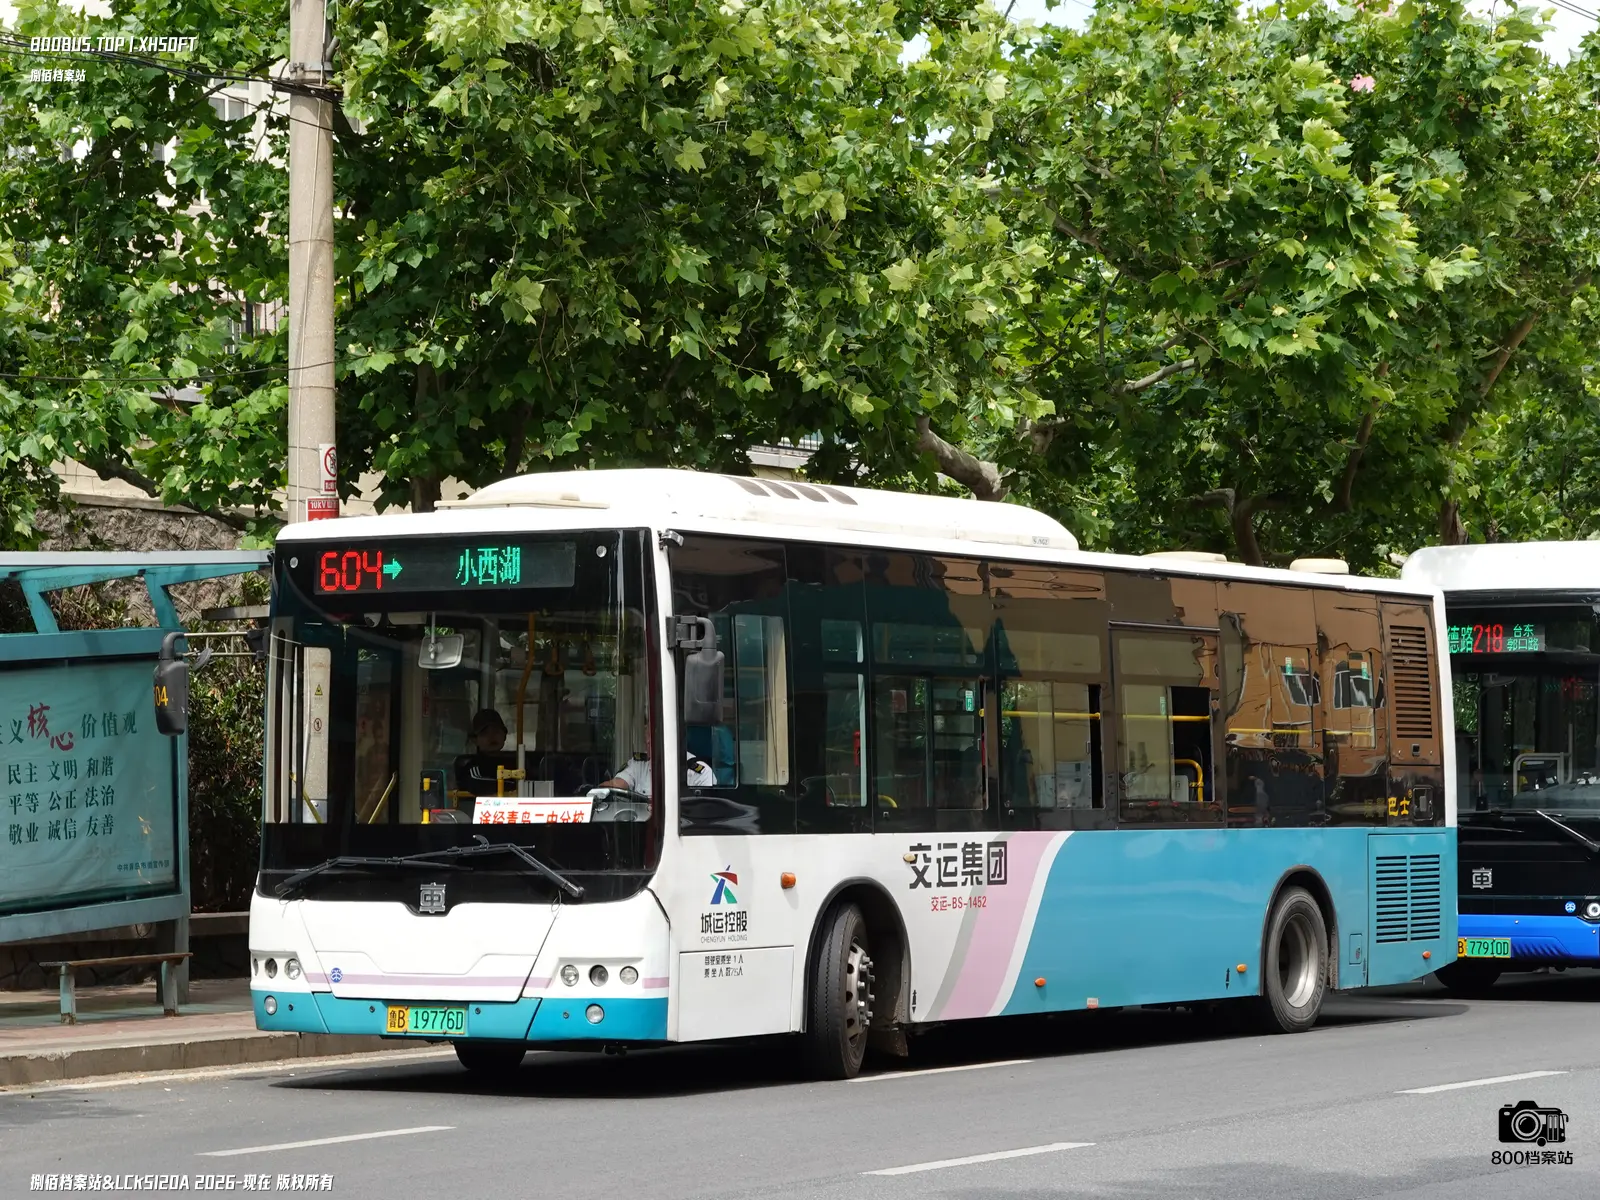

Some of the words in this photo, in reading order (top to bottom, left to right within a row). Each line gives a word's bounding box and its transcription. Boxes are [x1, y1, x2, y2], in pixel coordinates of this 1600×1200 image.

[320, 551, 382, 591] 604
[456, 546, 520, 585] 小西湖
[1473, 623, 1503, 653] 218
[1513, 623, 1534, 638] 台东
[154, 685, 169, 707] 04
[0, 702, 138, 751] 义核心价值观
[8, 762, 38, 785] 民主
[47, 759, 78, 782] 文明
[87, 755, 114, 778] 和谐
[8, 792, 39, 815] 平等
[48, 789, 77, 811] 公正
[85, 785, 115, 808] 法治
[9, 822, 39, 845] 敬业
[48, 818, 77, 841] 诚信
[86, 814, 114, 837] 友善
[909, 841, 1008, 889] 交运集团
[931, 896, 987, 911] 交运-BS-1452
[701, 911, 748, 934] 城运控股
